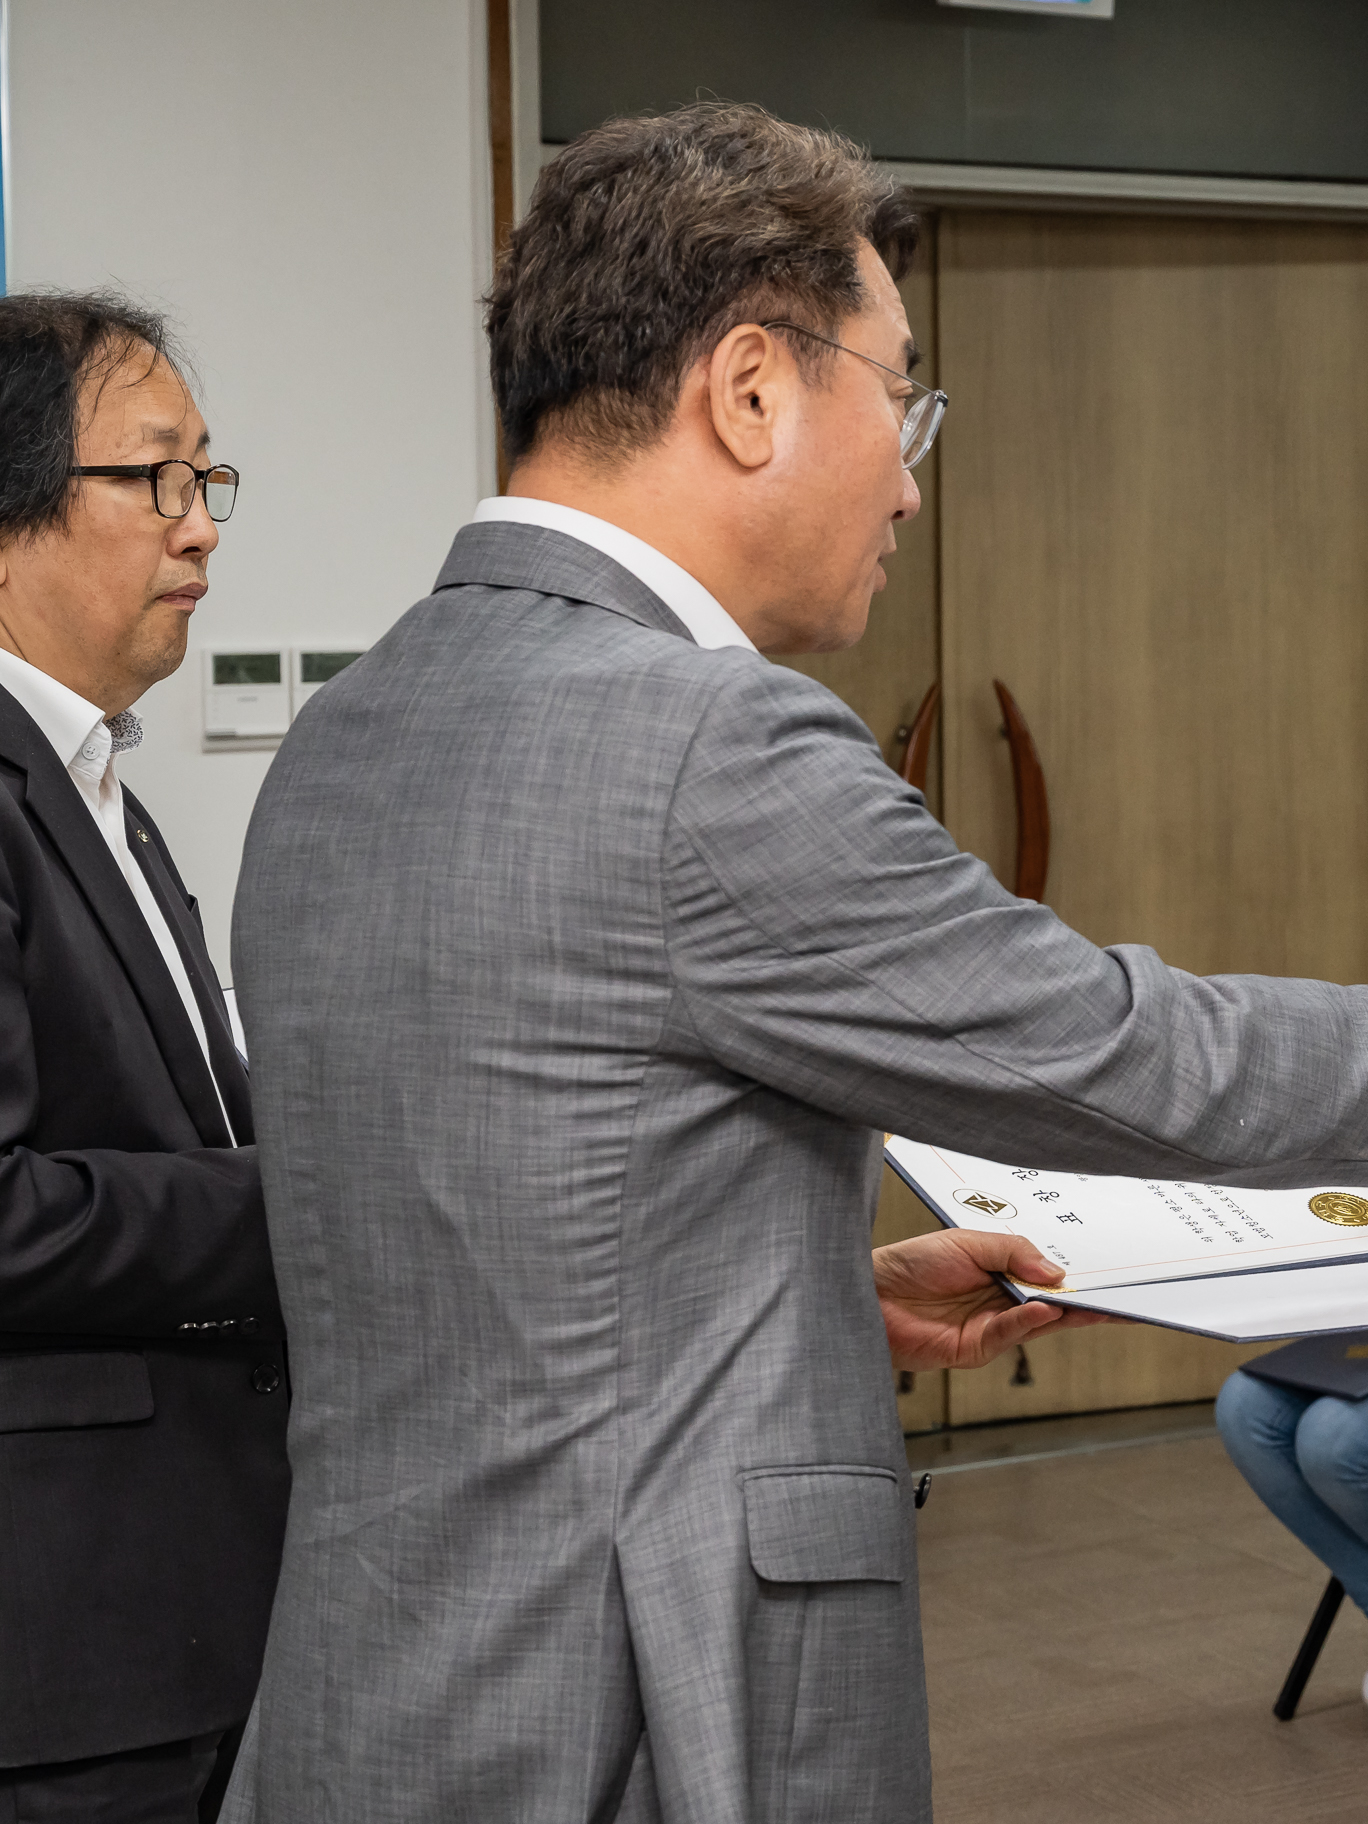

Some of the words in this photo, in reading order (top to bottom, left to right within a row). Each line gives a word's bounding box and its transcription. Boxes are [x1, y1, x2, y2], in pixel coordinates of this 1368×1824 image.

[1147, 1184, 1166, 1198] 바른
[1184, 1191, 1204, 1205] 타의
[1165, 1199, 1183, 1213] 평소
[1179, 1214, 1204, 1234] 학생은
[1202, 1207, 1228, 1228] 자세로
[1220, 1196, 1274, 1240] 모범청소년으로
[1225, 1230, 1245, 1243] 학업
